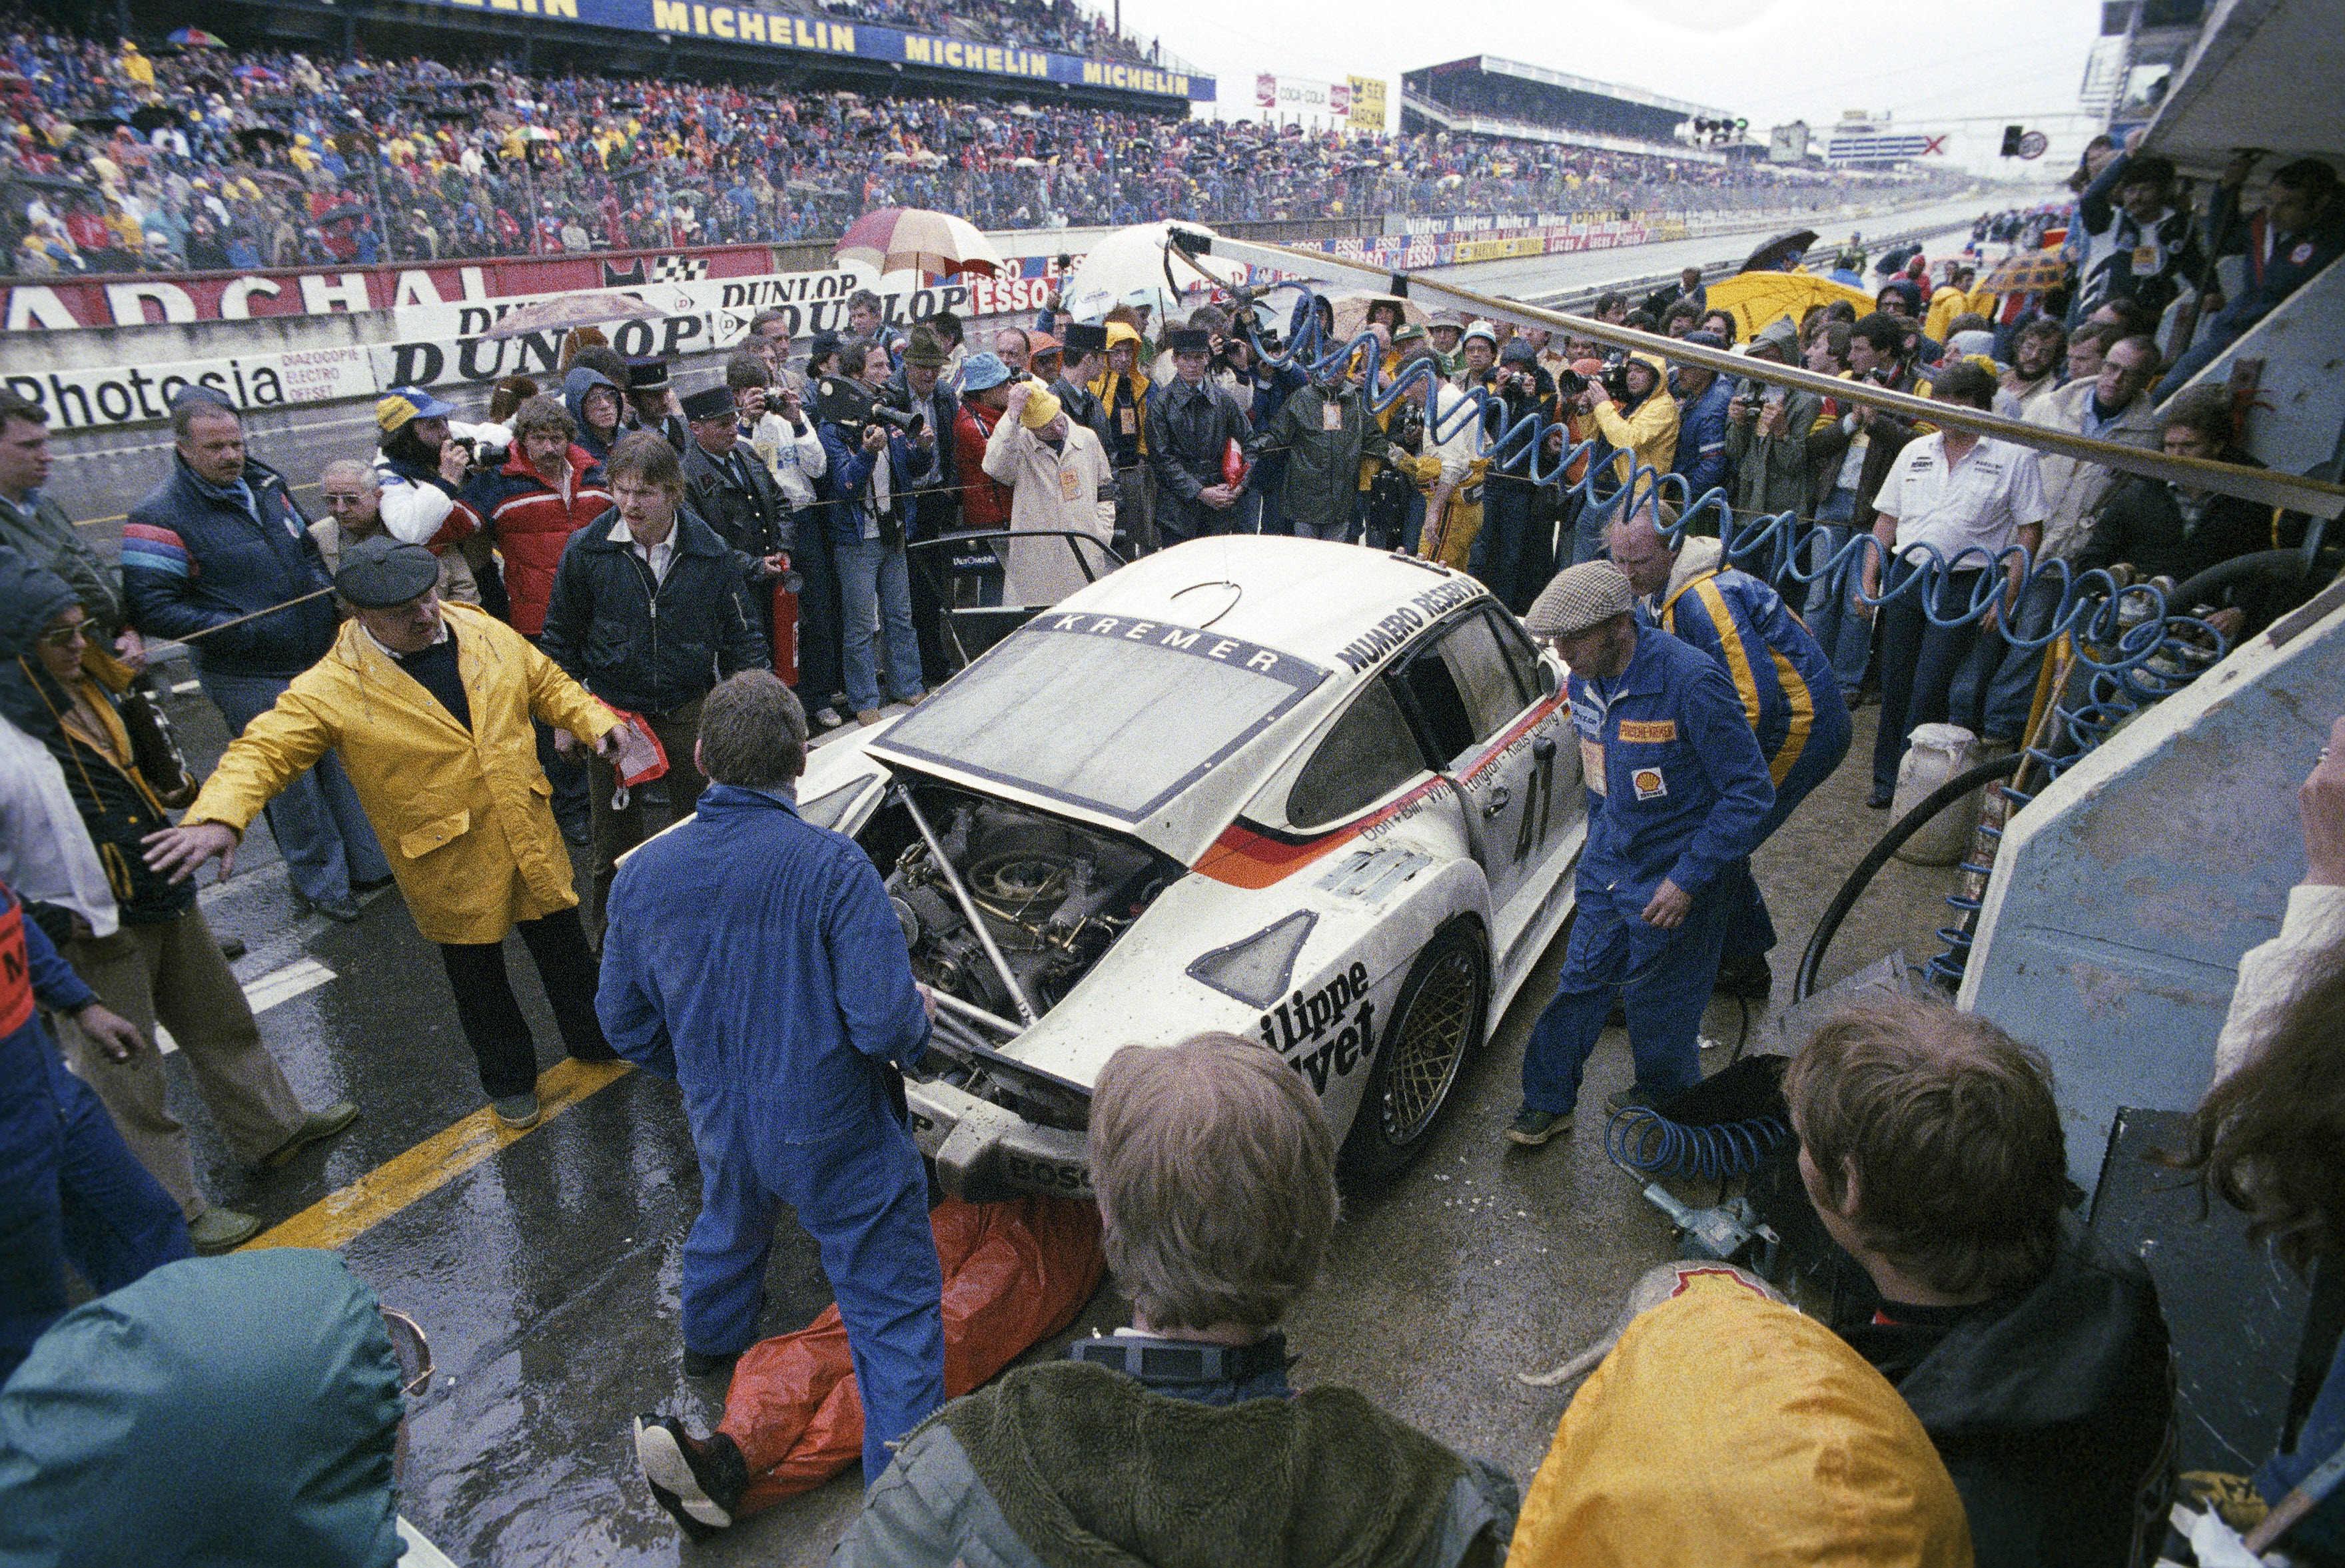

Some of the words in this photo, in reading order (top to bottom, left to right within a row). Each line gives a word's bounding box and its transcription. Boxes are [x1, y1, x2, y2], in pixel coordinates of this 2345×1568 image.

[653, 0, 855, 53] MICHELIN
[905, 35, 1047, 77] MICHELIN
[1083, 61, 1189, 96] MICHELIN
[1335, 238, 1364, 256] ESSO
[1375, 236, 1400, 251] ESSO
[1407, 245, 1436, 268] ESSO
[721, 273, 857, 308] DUNLOP
[977, 278, 1049, 314] ESSO
[385, 316, 702, 390] DUNOP
[1053, 613, 1278, 671] KREMER
[1335, 606, 1424, 675] NUMERO
[1358, 817, 1395, 842] Don
[1396, 797, 1423, 820] Bill
[1422, 757, 1503, 804] Whttington
